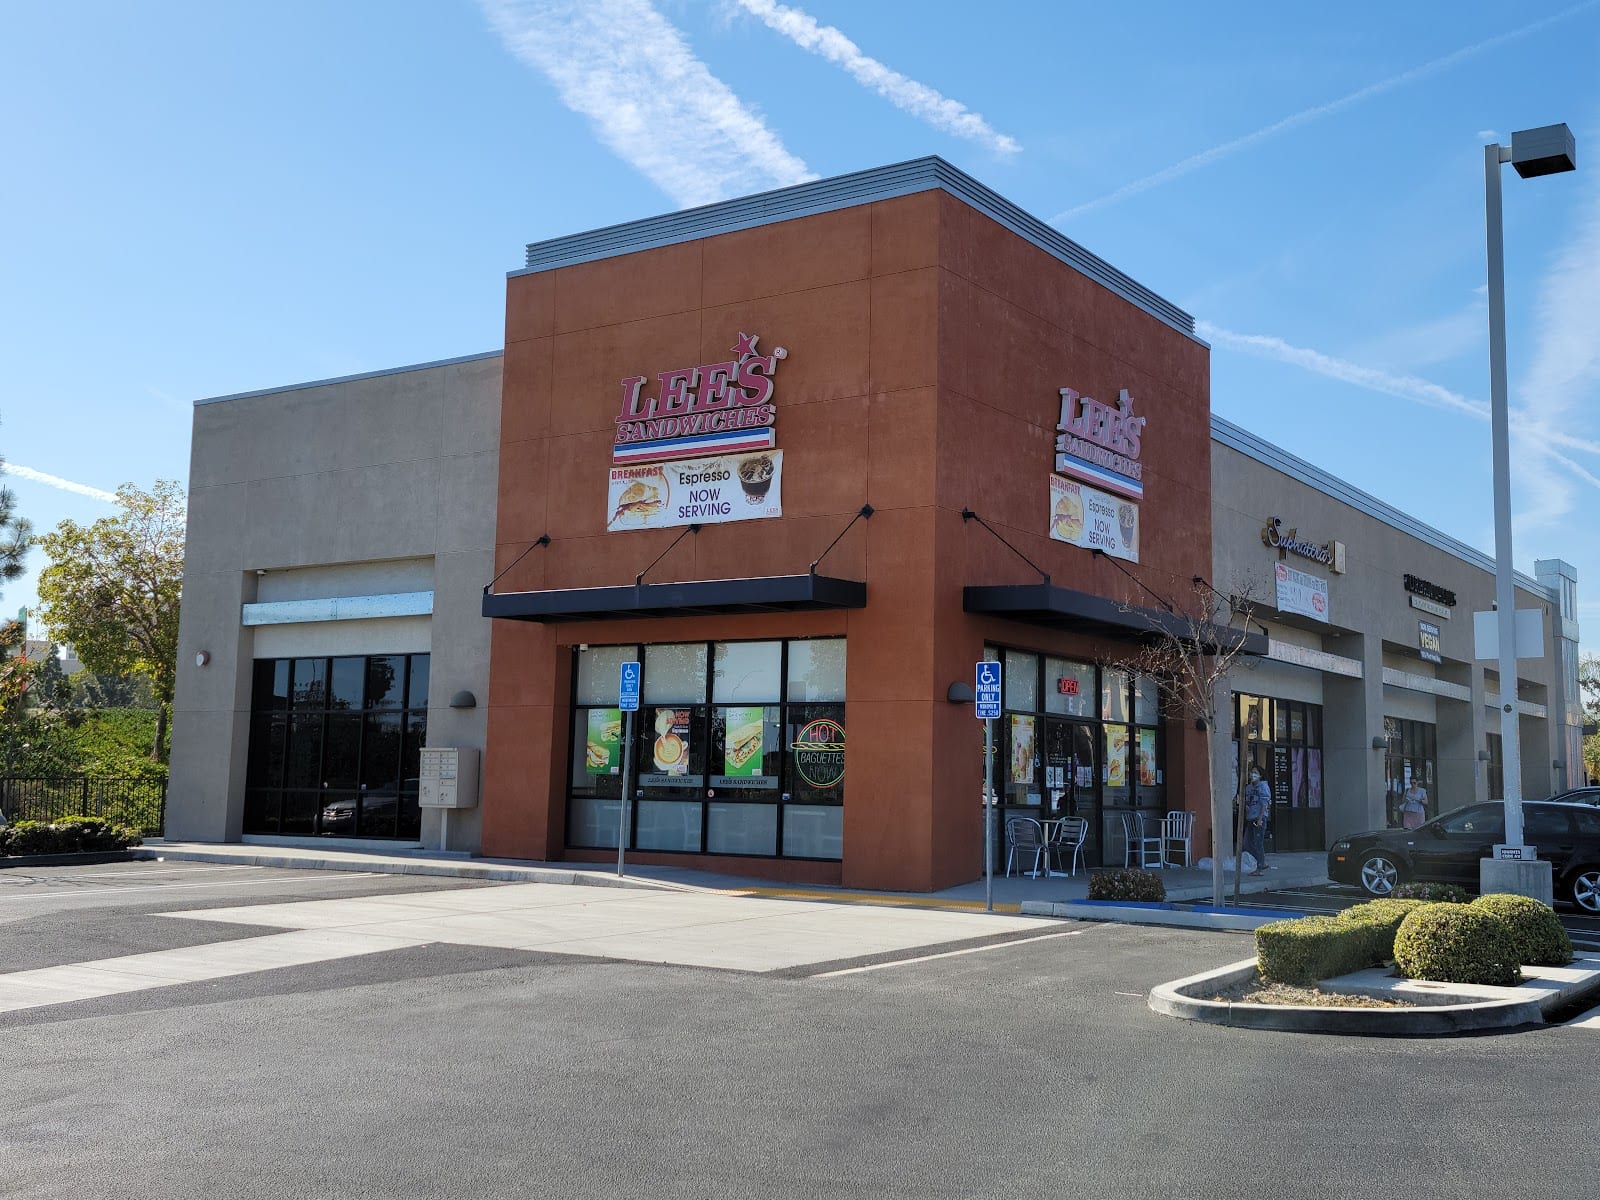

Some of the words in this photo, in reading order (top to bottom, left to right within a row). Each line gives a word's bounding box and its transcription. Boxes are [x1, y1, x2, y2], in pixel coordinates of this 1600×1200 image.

[615, 354, 775, 423] LEE'S
[615, 404, 777, 444] SANDWICHES
[1057, 387, 1142, 460] LEE'S
[1055, 433, 1143, 481] SANDWICHES
[611, 465, 665, 480] BREAKFAST
[679, 469, 731, 487] Espresso
[689, 488, 721, 504] NOW
[678, 502, 731, 518] SERVING
[1088, 499, 1115, 518] Espresso
[1094, 518, 1110, 535] NOW
[1088, 531, 1116, 549] SERVING
[1420, 631, 1440, 652] VEGAN
[977, 684, 1000, 692] PARKING
[1062, 680, 1078, 693] OPEN
[981, 693, 995, 702] ONLY
[809, 723, 837, 743] HOT
